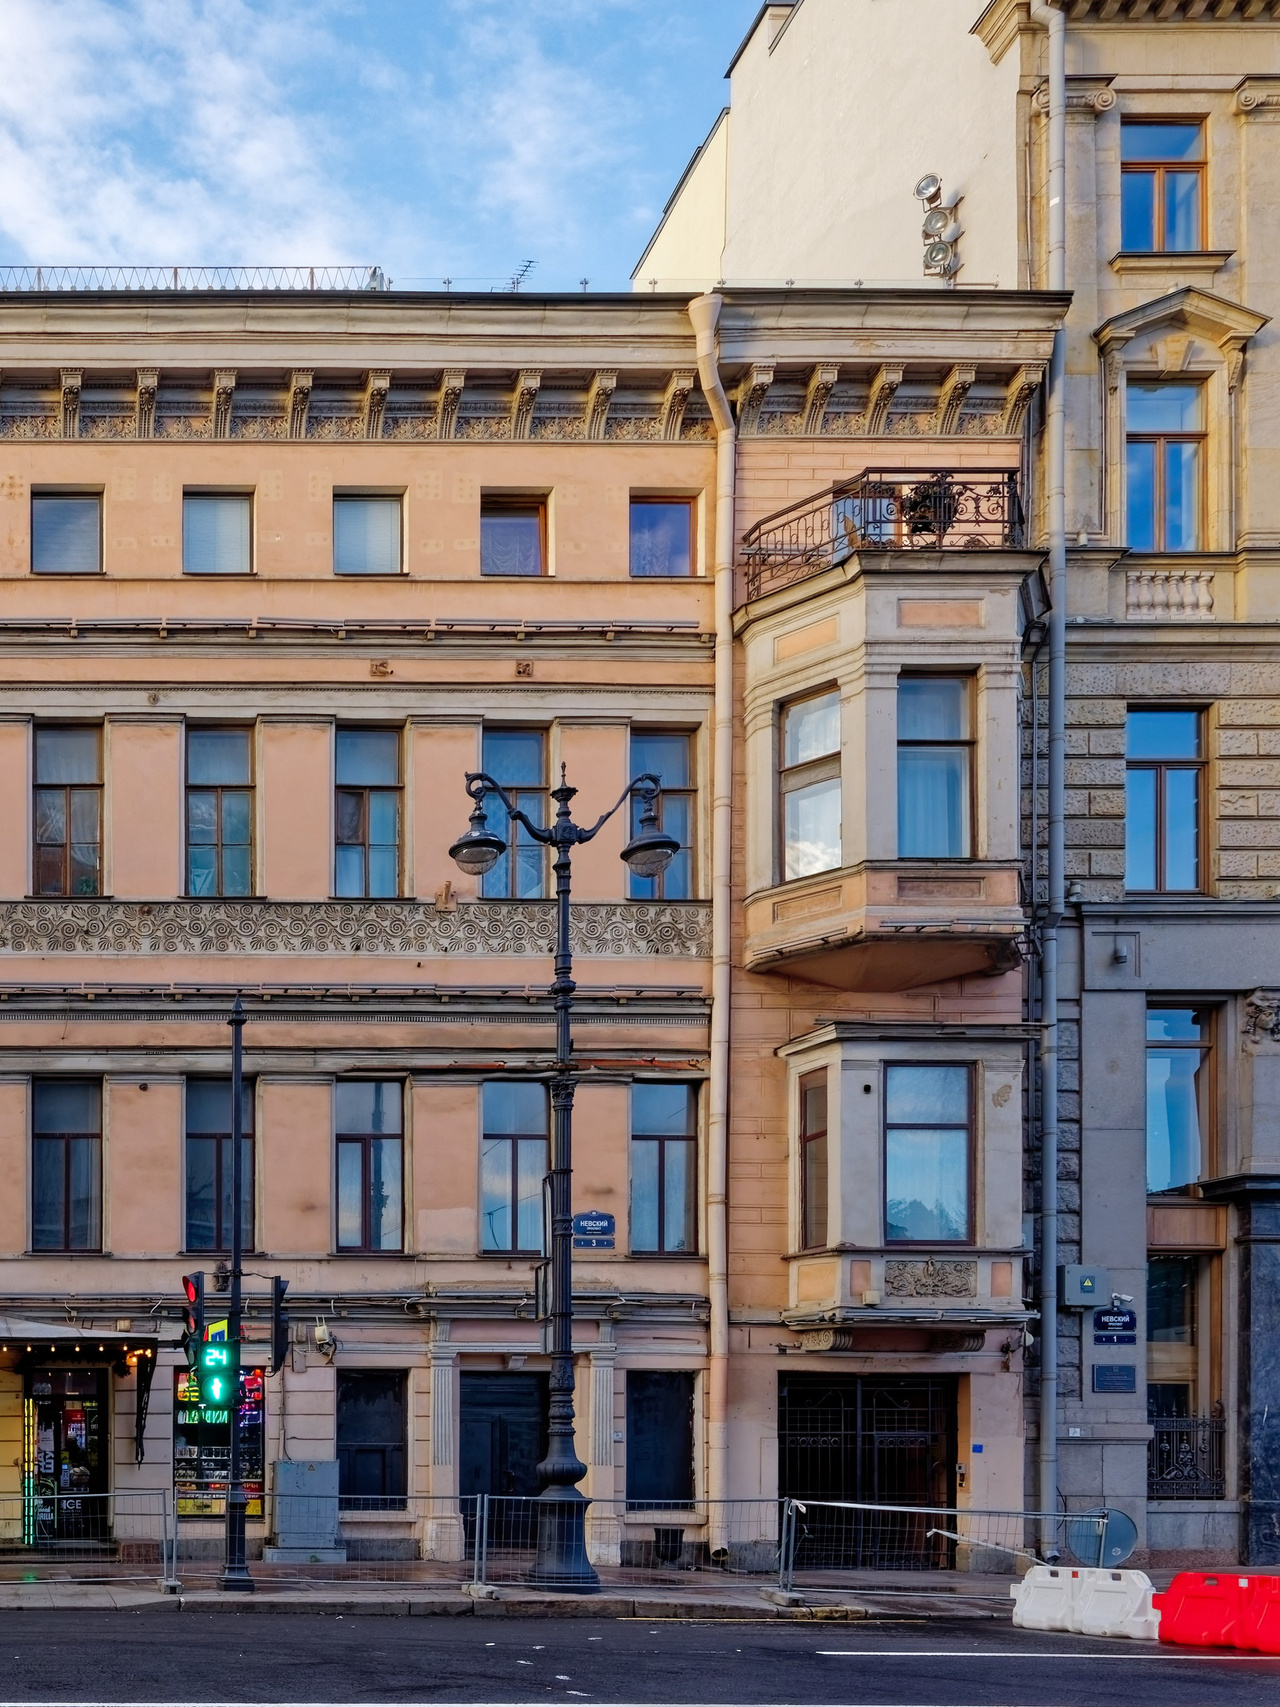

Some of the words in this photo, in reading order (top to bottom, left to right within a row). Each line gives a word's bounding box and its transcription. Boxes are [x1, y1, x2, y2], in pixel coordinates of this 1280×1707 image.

[580, 1219, 609, 1227] НЕВСКИЙ
[591, 1239, 596, 1247] 3
[1101, 1314, 1130, 1323] НЕВСКИЙ
[205, 1348, 227, 1366] 24
